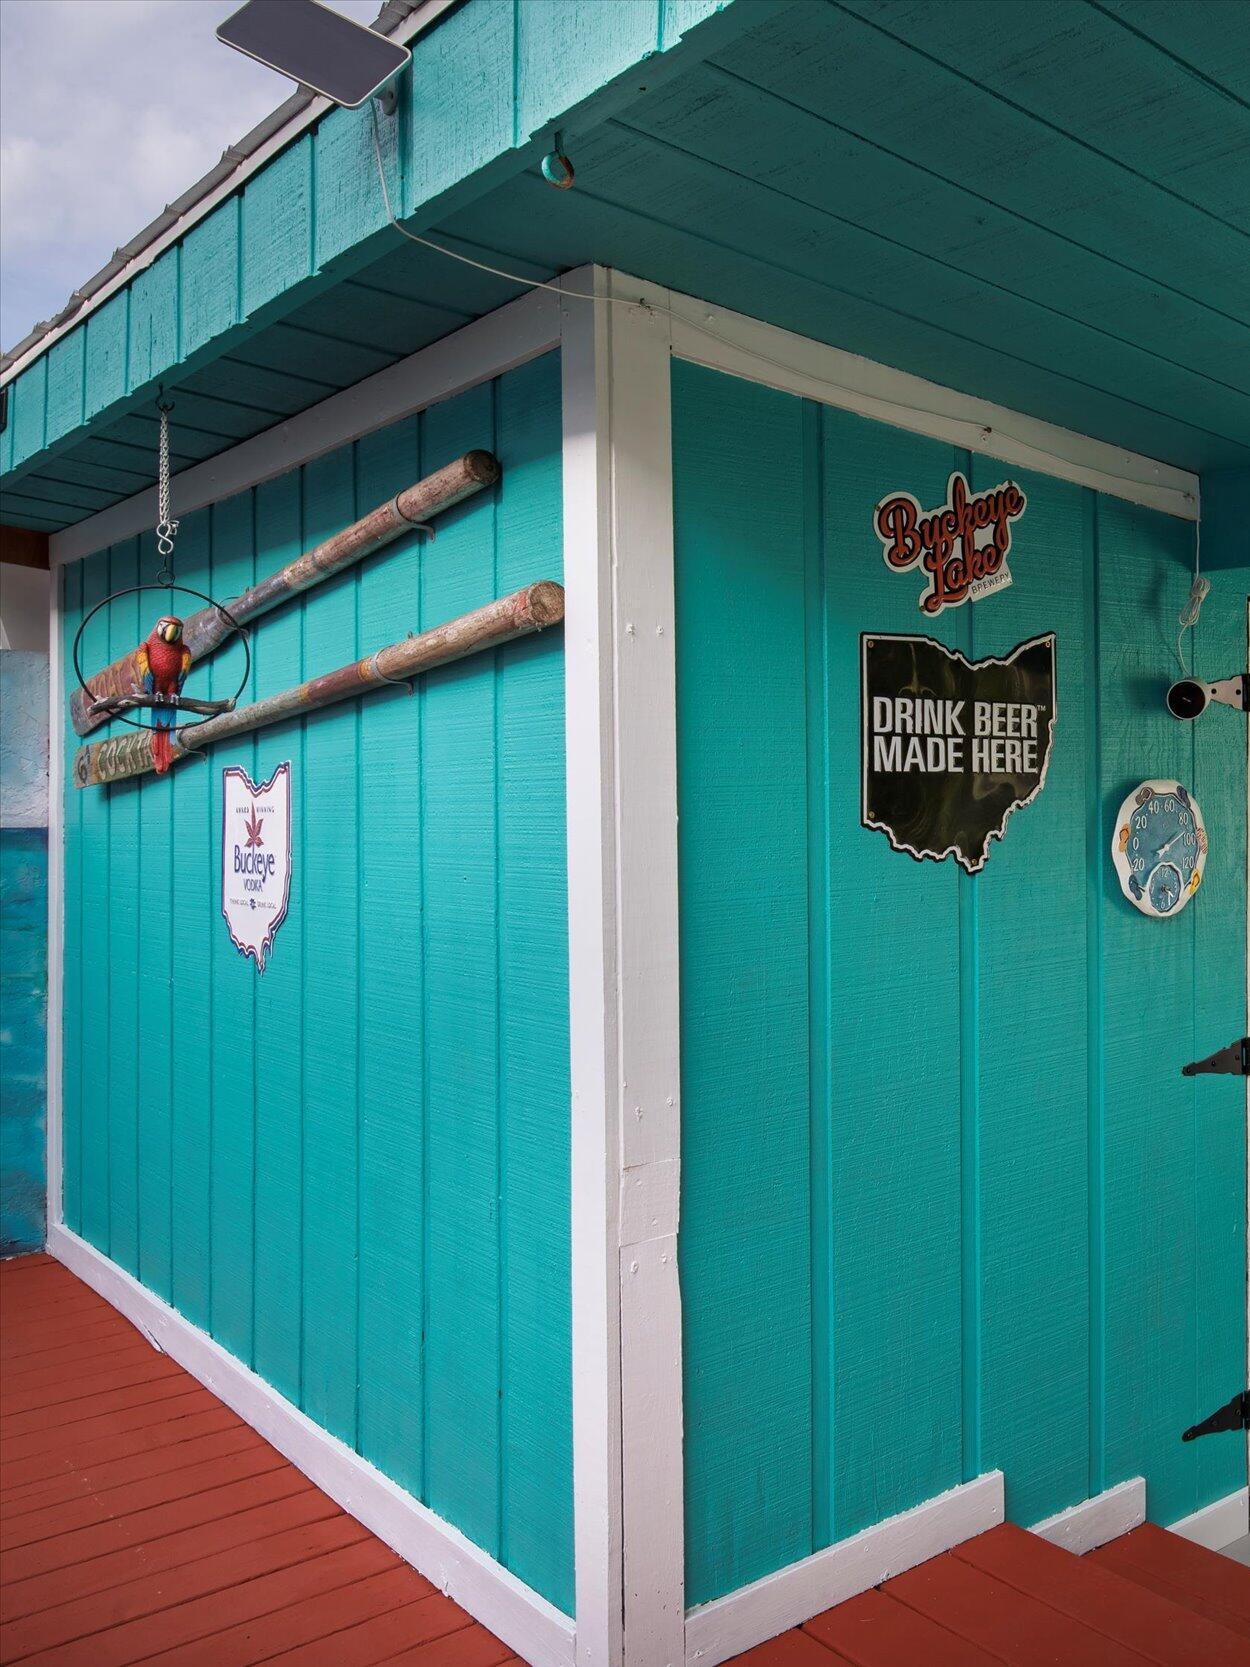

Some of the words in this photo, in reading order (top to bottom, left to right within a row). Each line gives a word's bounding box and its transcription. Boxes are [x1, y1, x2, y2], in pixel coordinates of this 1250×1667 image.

[877, 475, 1024, 568] Buckeye
[923, 529, 1004, 612] Lake
[872, 696, 967, 736] DRINK
[97, 731, 154, 780] COCKTA
[873, 735, 964, 774] MADE
[971, 738, 1038, 774] HERE
[1135, 815, 1147, 829] 20
[1148, 801, 1160, 814] 40
[1164, 799, 1175, 812] 60
[1178, 812, 1189, 825] 80
[234, 844, 276, 884] Buckeye
[243, 878, 263, 892] VODKA
